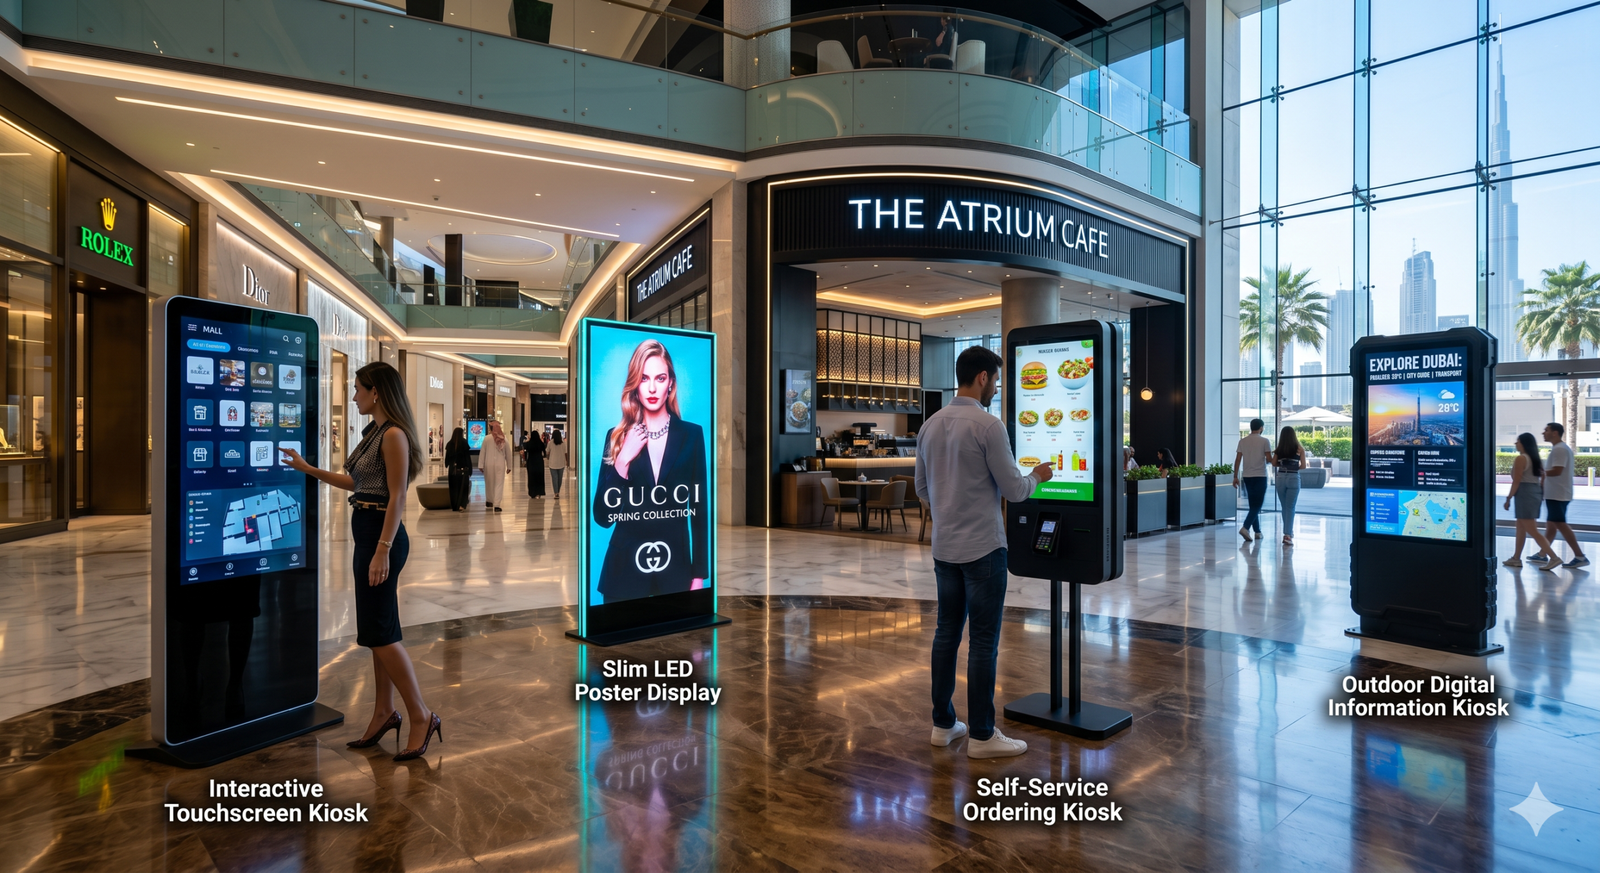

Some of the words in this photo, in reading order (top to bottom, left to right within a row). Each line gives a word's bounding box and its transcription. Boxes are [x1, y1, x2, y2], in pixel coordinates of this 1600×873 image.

[848, 198, 925, 230] THE
[936, 199, 1055, 243] ATRIUM
[1061, 219, 1109, 259] CAFE
[80, 226, 134, 267] ROLEX
[242, 263, 270, 306] Dior
[636, 278, 648, 303] THE
[647, 260, 671, 297] ATRIUM
[671, 244, 693, 279] CAFE
[202, 325, 223, 335] MALL
[1369, 355, 1420, 372] EXPLORE
[1422, 352, 1462, 369] DUBAI:
[1435, 369, 1462, 378] TRANSPORT
[603, 483, 700, 508] GUCCI
[607, 511, 640, 523] SPRING
[643, 508, 696, 520] COLLECTION
